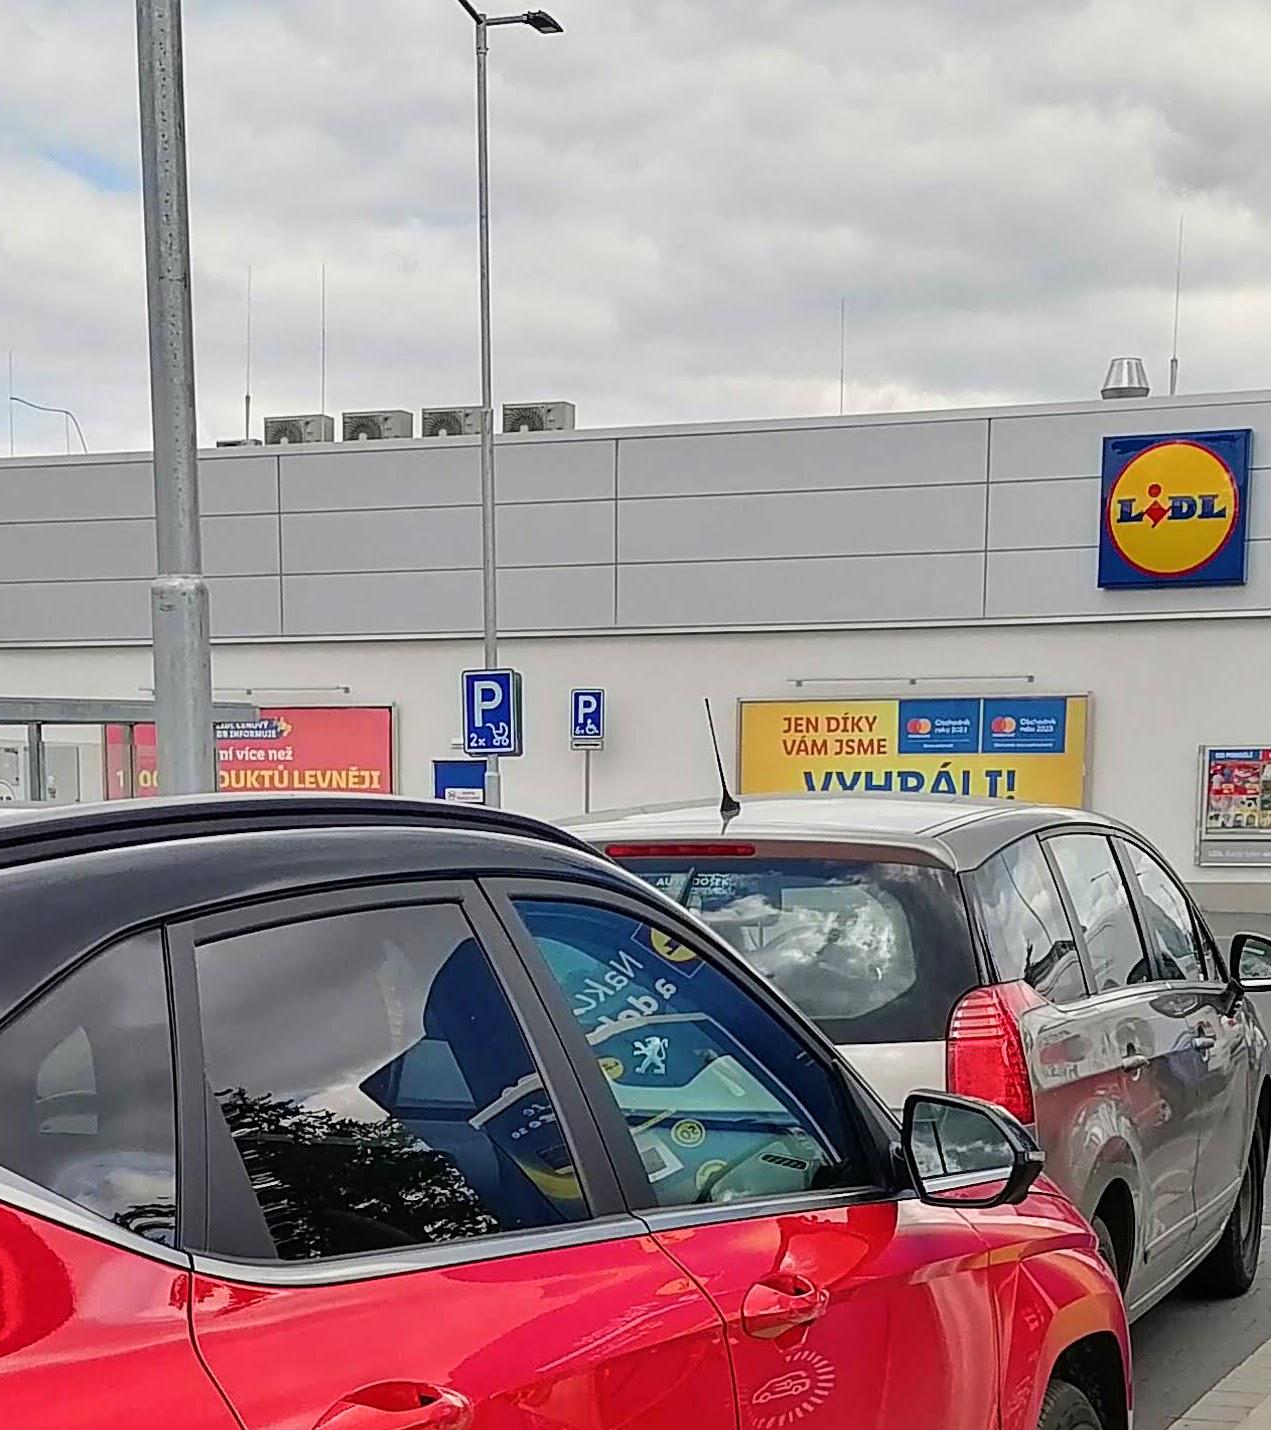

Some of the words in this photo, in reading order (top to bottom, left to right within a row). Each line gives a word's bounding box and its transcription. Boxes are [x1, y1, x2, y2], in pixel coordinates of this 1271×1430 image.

[474, 680, 503, 728] P
[578, 695, 597, 724] P
[782, 716, 819, 734] JEN
[826, 712, 878, 733] DÍKY
[469, 733, 486, 747] 2x
[782, 735, 831, 756] VÁM
[833, 738, 888, 756] JSME
[236, 747, 265, 761] více
[267, 746, 293, 761] než
[293, 766, 381, 789] LEVNĚJI
